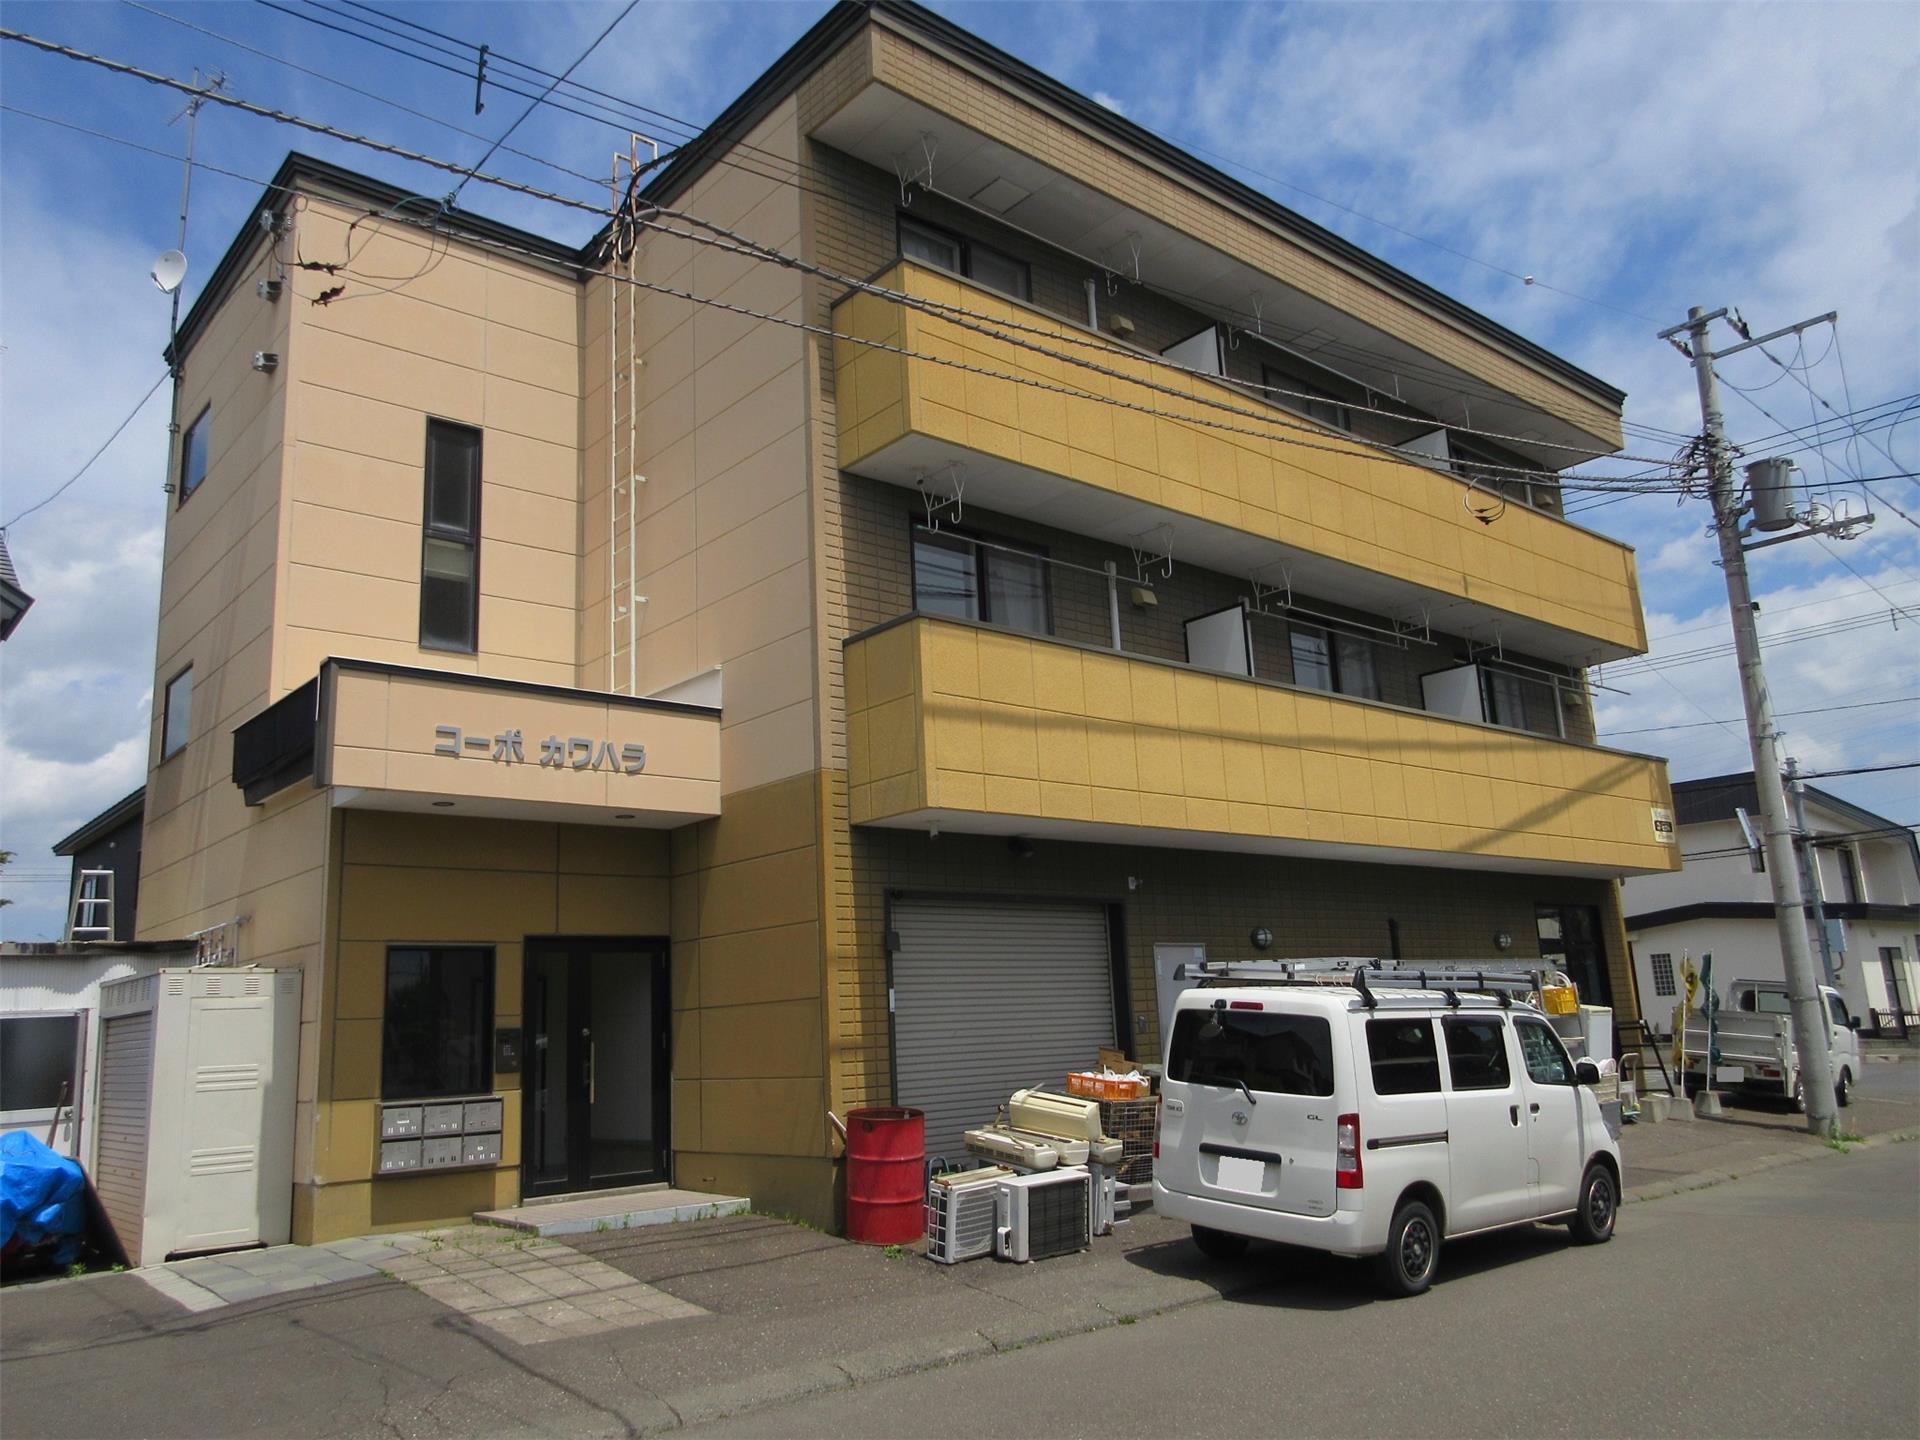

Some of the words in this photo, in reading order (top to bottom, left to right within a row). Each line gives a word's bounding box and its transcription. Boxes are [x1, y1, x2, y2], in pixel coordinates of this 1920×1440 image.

[435, 725, 525, 766] コーポ
[539, 735, 647, 774] カワハラ
